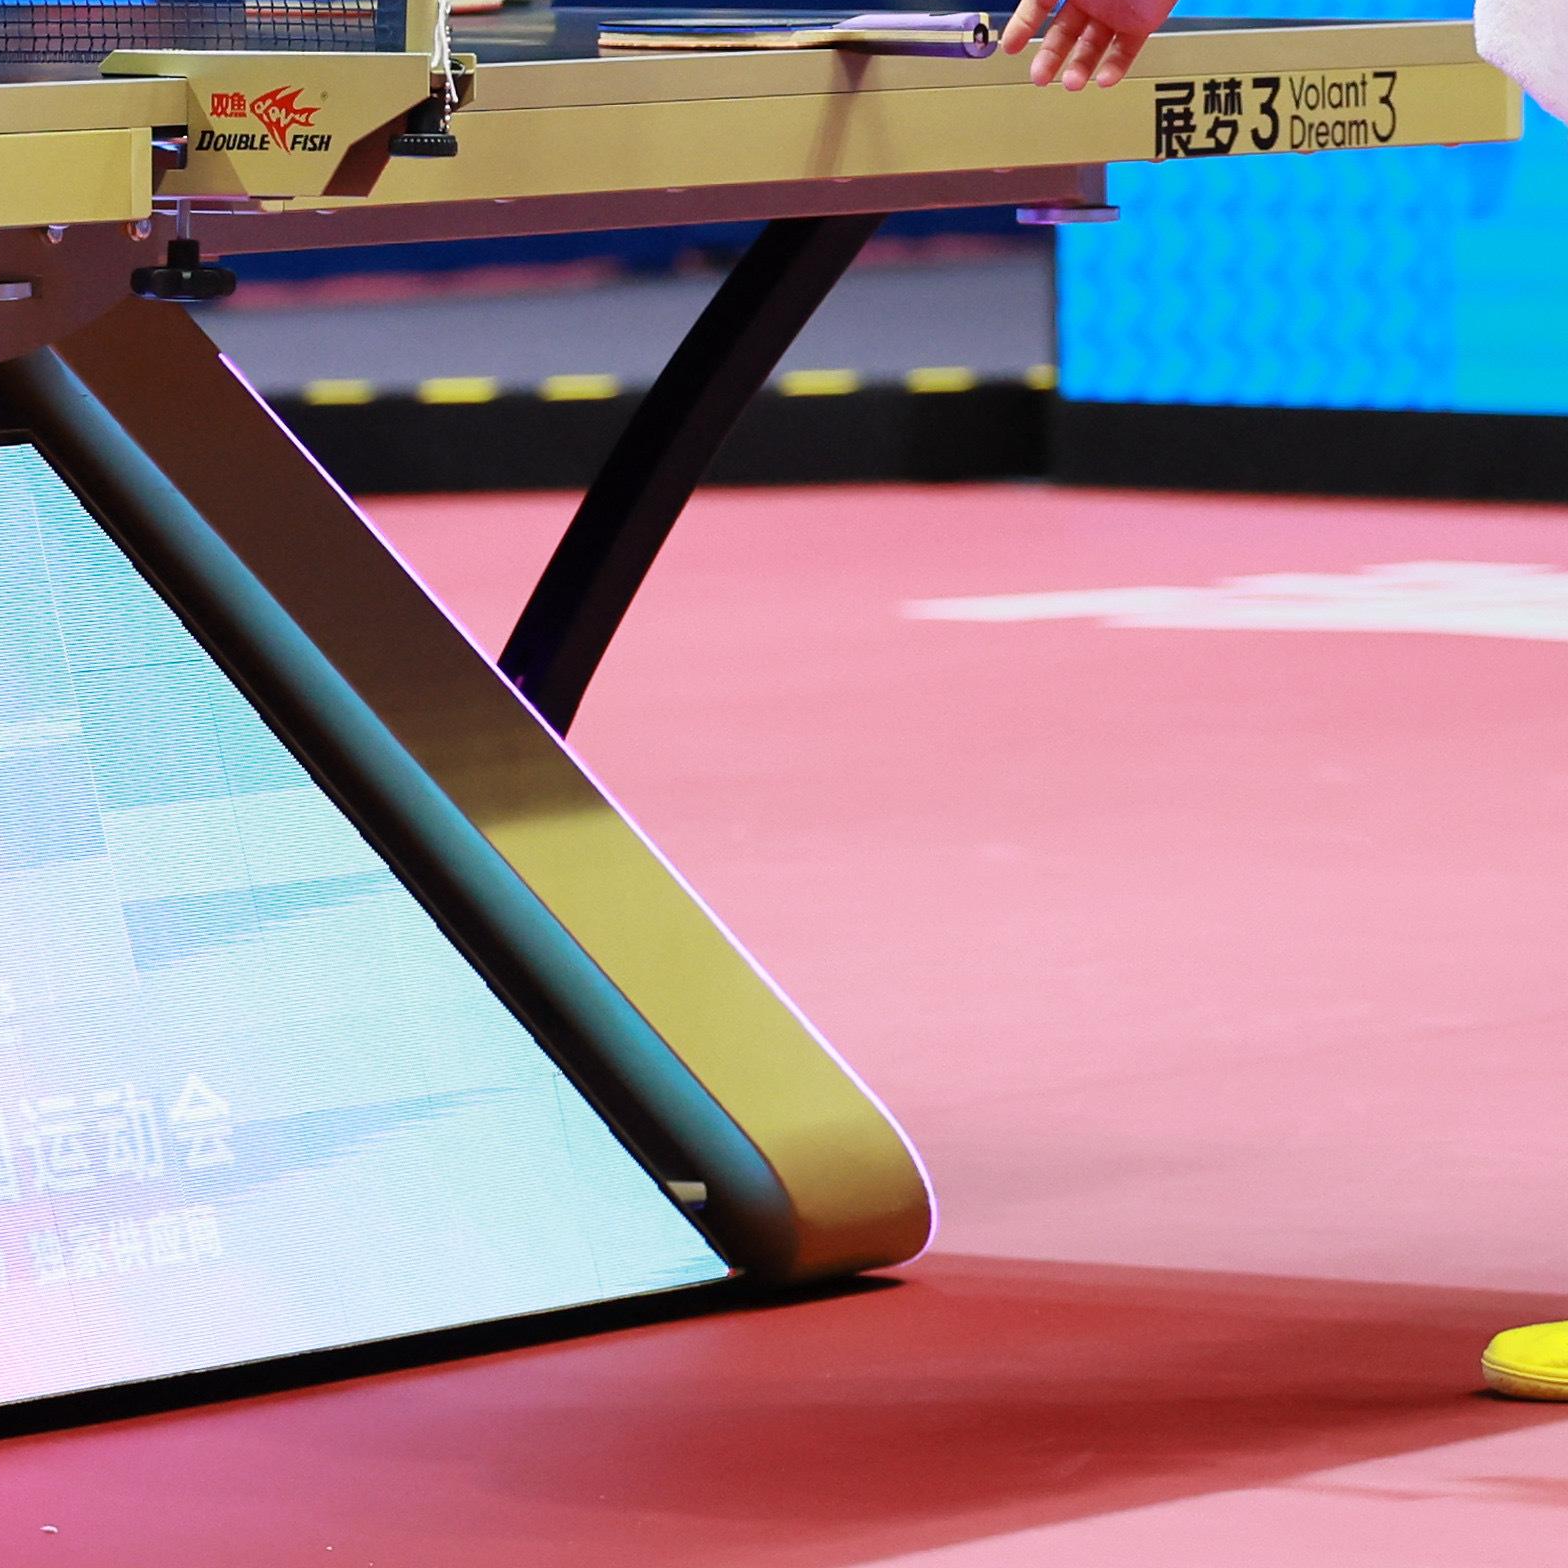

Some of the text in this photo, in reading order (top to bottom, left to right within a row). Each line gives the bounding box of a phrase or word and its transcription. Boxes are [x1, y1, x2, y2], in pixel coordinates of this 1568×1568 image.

[210, 92, 247, 118] 双鱼
[1289, 72, 1368, 111] Volant
[195, 130, 332, 152] DOUBLE FISH
[1289, 114, 1368, 150] Dream
